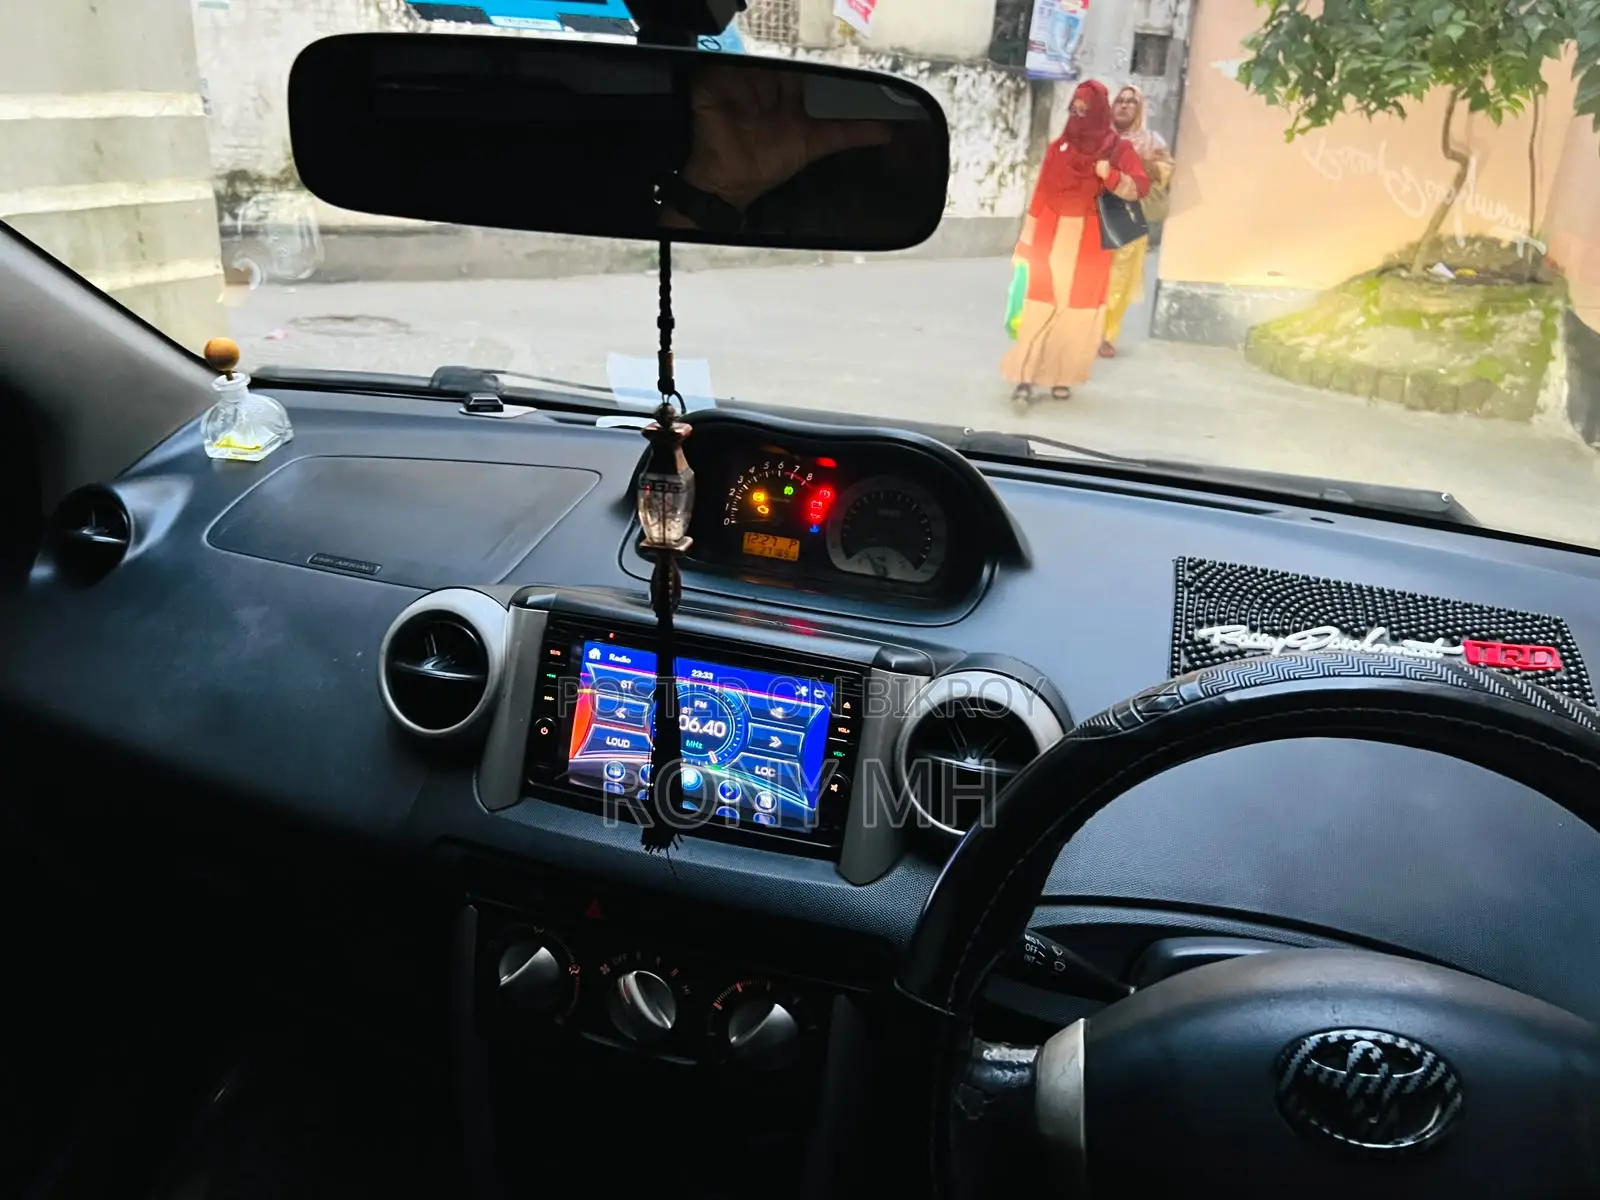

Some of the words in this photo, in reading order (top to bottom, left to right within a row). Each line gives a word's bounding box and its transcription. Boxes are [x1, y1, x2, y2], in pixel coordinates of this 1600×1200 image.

[763, 461, 770, 470] 5
[778, 461, 784, 469] 6
[794, 465, 800, 473] 7
[749, 466, 756, 474] 4
[737, 475, 744, 484] 3
[806, 473, 813, 481] 8
[729, 488, 736, 496] 2
[725, 503, 729, 511] 1
[723, 518, 730, 526] 0
[608, 653, 632, 664] Radio
[1470, 641, 1556, 667] TRD
[620, 680, 633, 689] ST
[694, 700, 708, 709] FM
[679, 714, 727, 738] 06.40
[605, 736, 631, 748] LOUD
[686, 740, 703, 749] MHz
[754, 765, 776, 778] LOC
[1025, 943, 1038, 955] OFF
